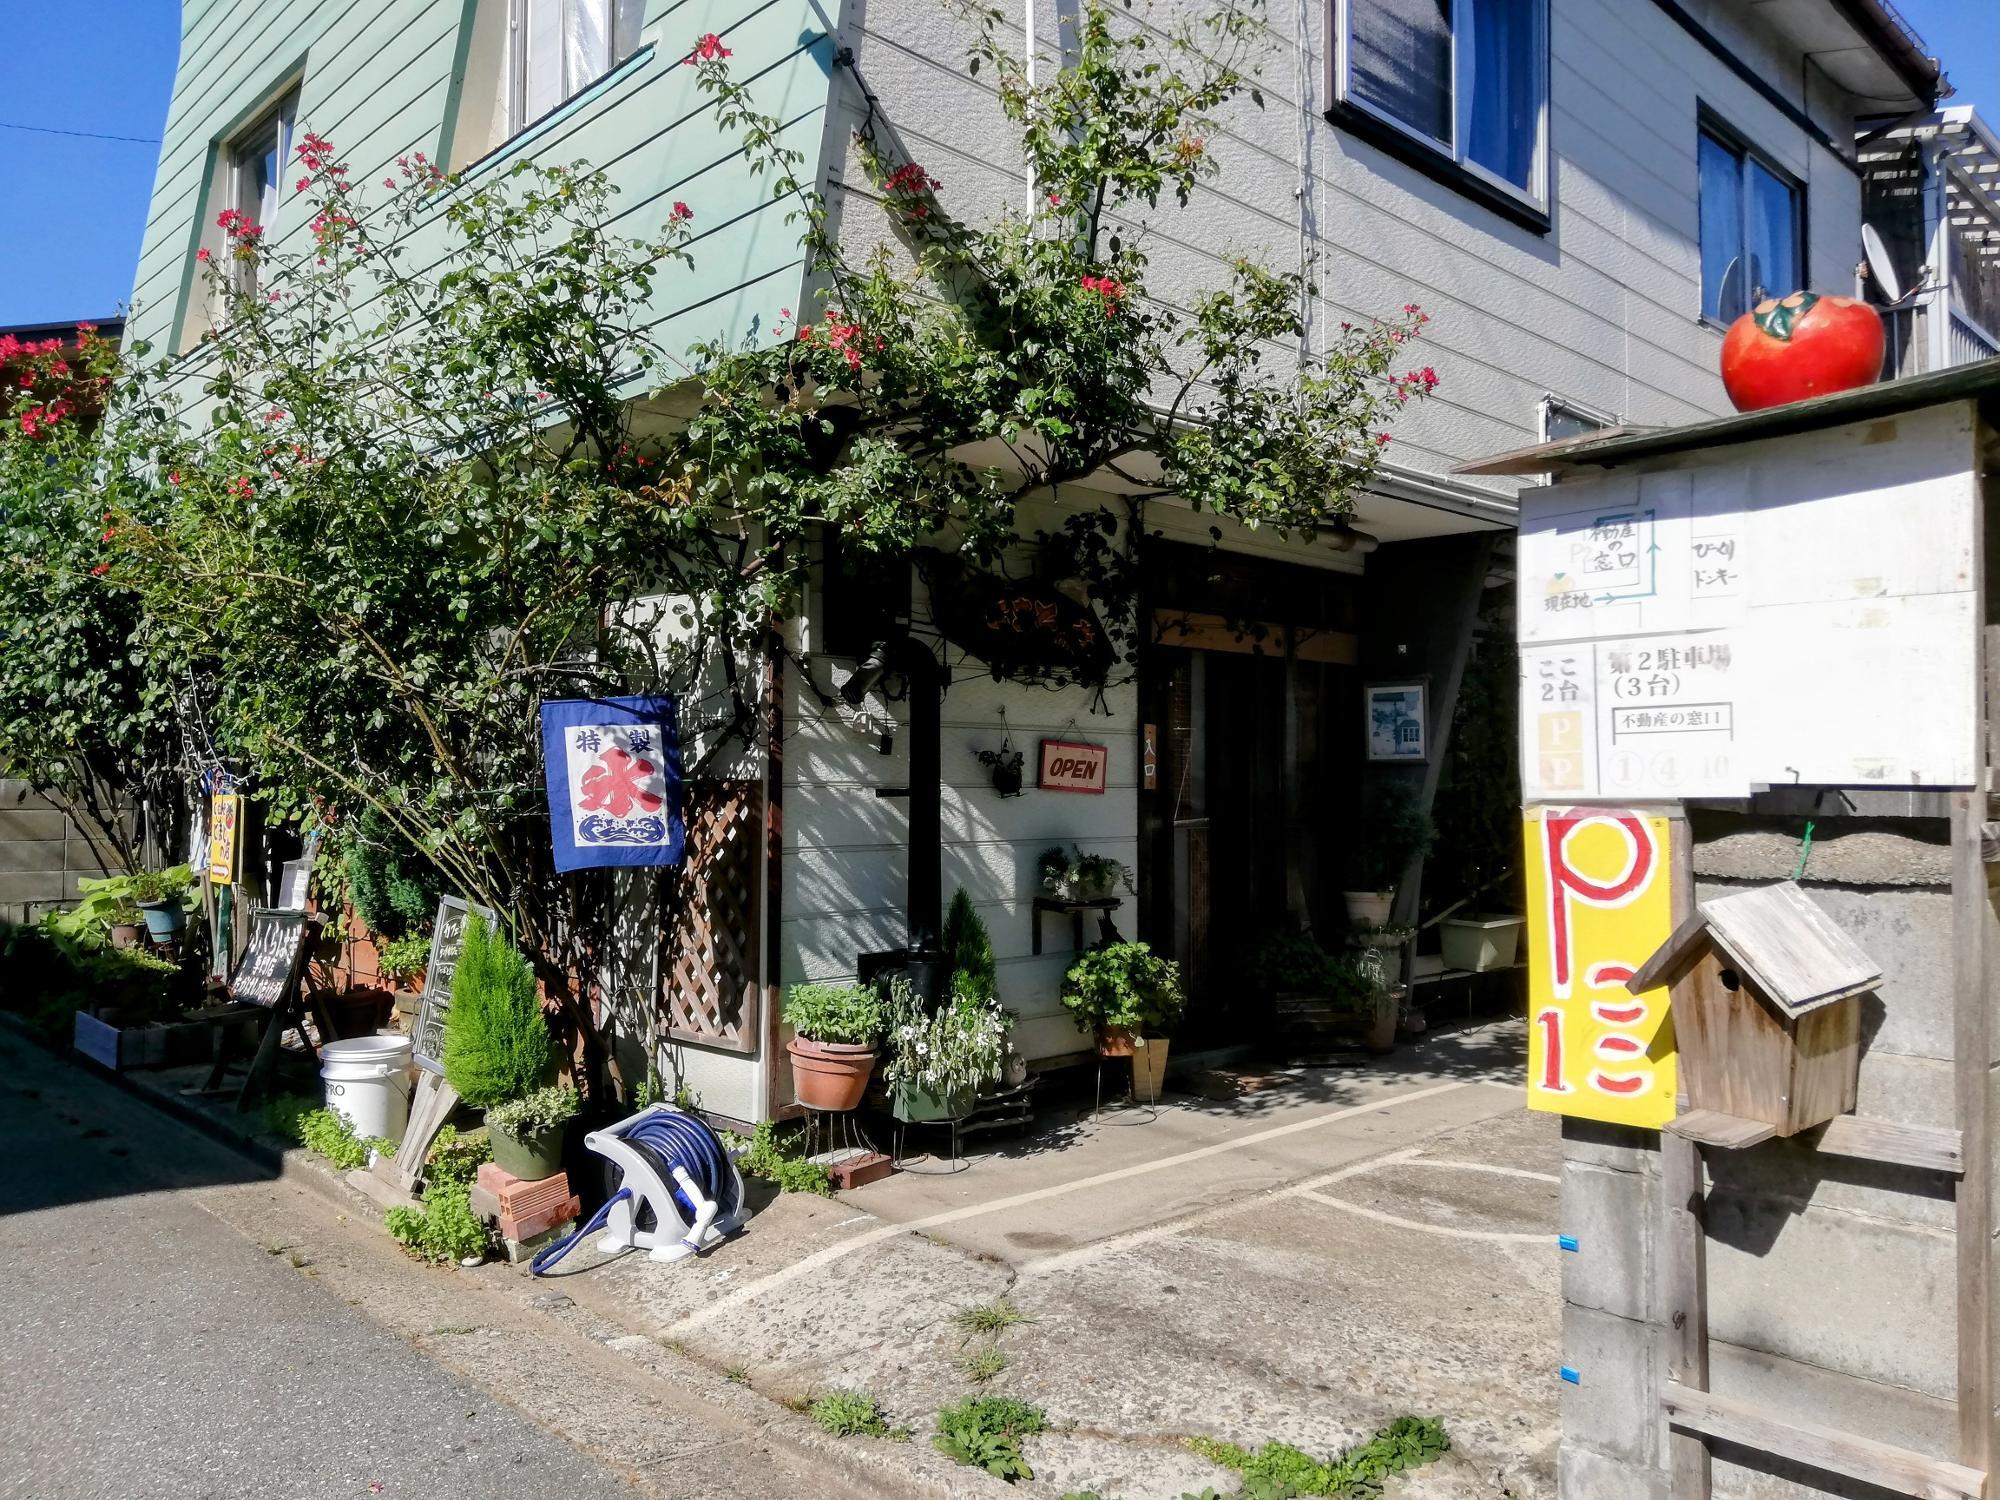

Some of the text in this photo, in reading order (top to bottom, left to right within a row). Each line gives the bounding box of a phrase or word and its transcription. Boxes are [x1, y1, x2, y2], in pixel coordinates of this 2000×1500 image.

[1694, 569, 1738, 589] ドンキー
[1543, 593, 1594, 612] 現在地
[1539, 657, 1577, 679] ここ
[1541, 679, 1580, 702] 2台
[1613, 672, 1681, 699] (3台)
[576, 729, 650, 753] 特製
[1551, 717, 1572, 746] P
[1049, 757, 1099, 780] OPEN
[1144, 739, 1157, 777] 入口
[576, 745, 664, 819] 氷
[1552, 757, 1572, 786] P
[1544, 808, 1655, 990] P
[249, 920, 302, 965] ふくらはぎ
[253, 953, 278, 977] 専門店
